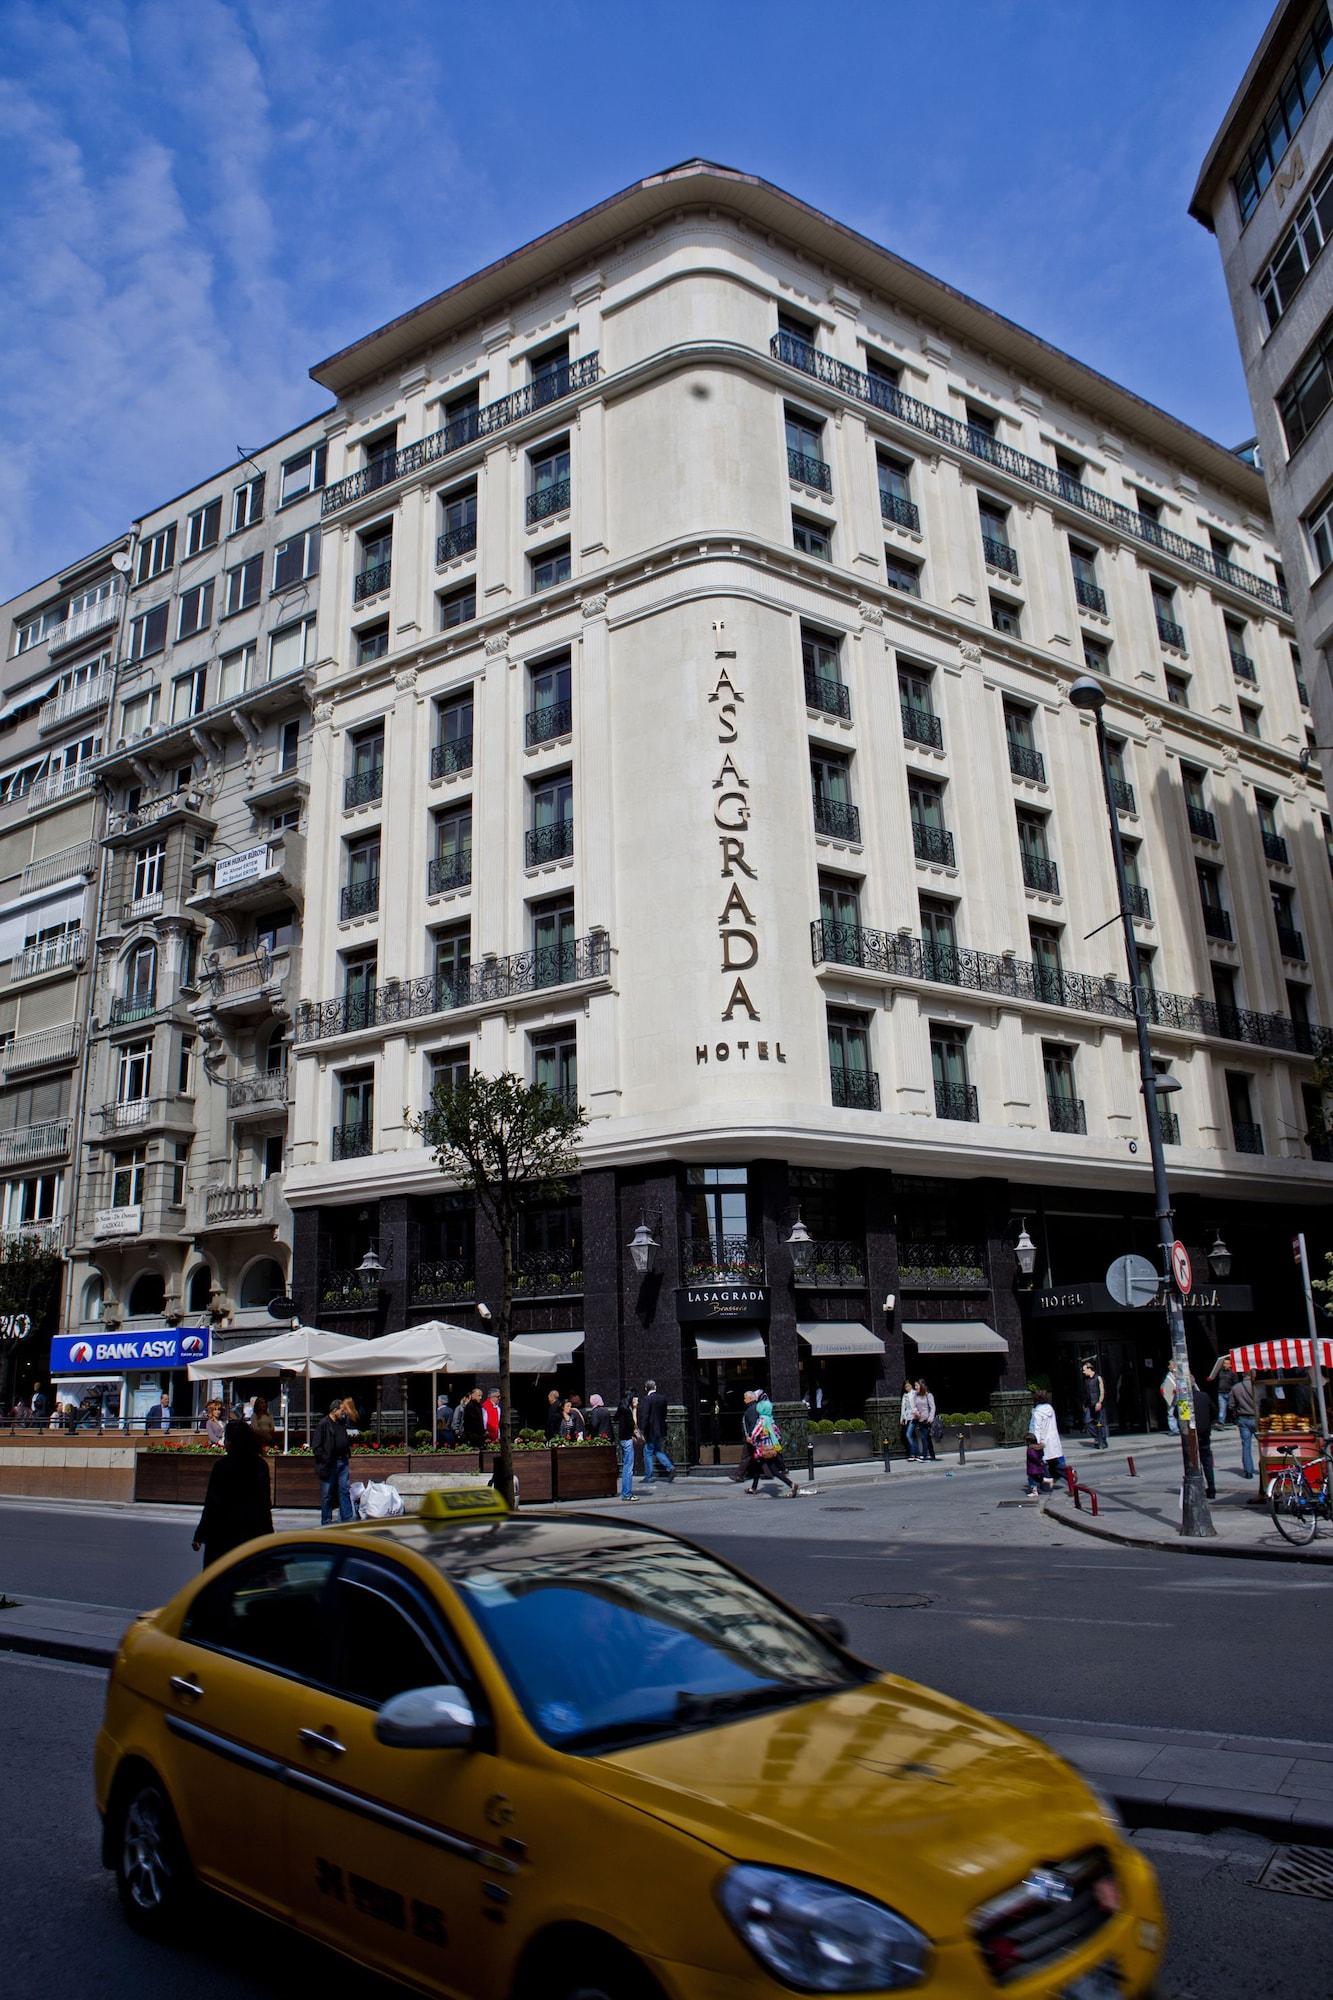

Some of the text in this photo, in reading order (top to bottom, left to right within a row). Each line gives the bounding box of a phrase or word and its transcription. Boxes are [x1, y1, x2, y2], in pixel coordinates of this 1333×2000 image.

[707, 620, 760, 1020] LASAGRADA
[695, 1041, 786, 1065] HOTEL
[688, 1290, 764, 1302] LASAGRADA
[1041, 1293, 1084, 1309] HOTEL
[96, 1343, 139, 1360] BANK
